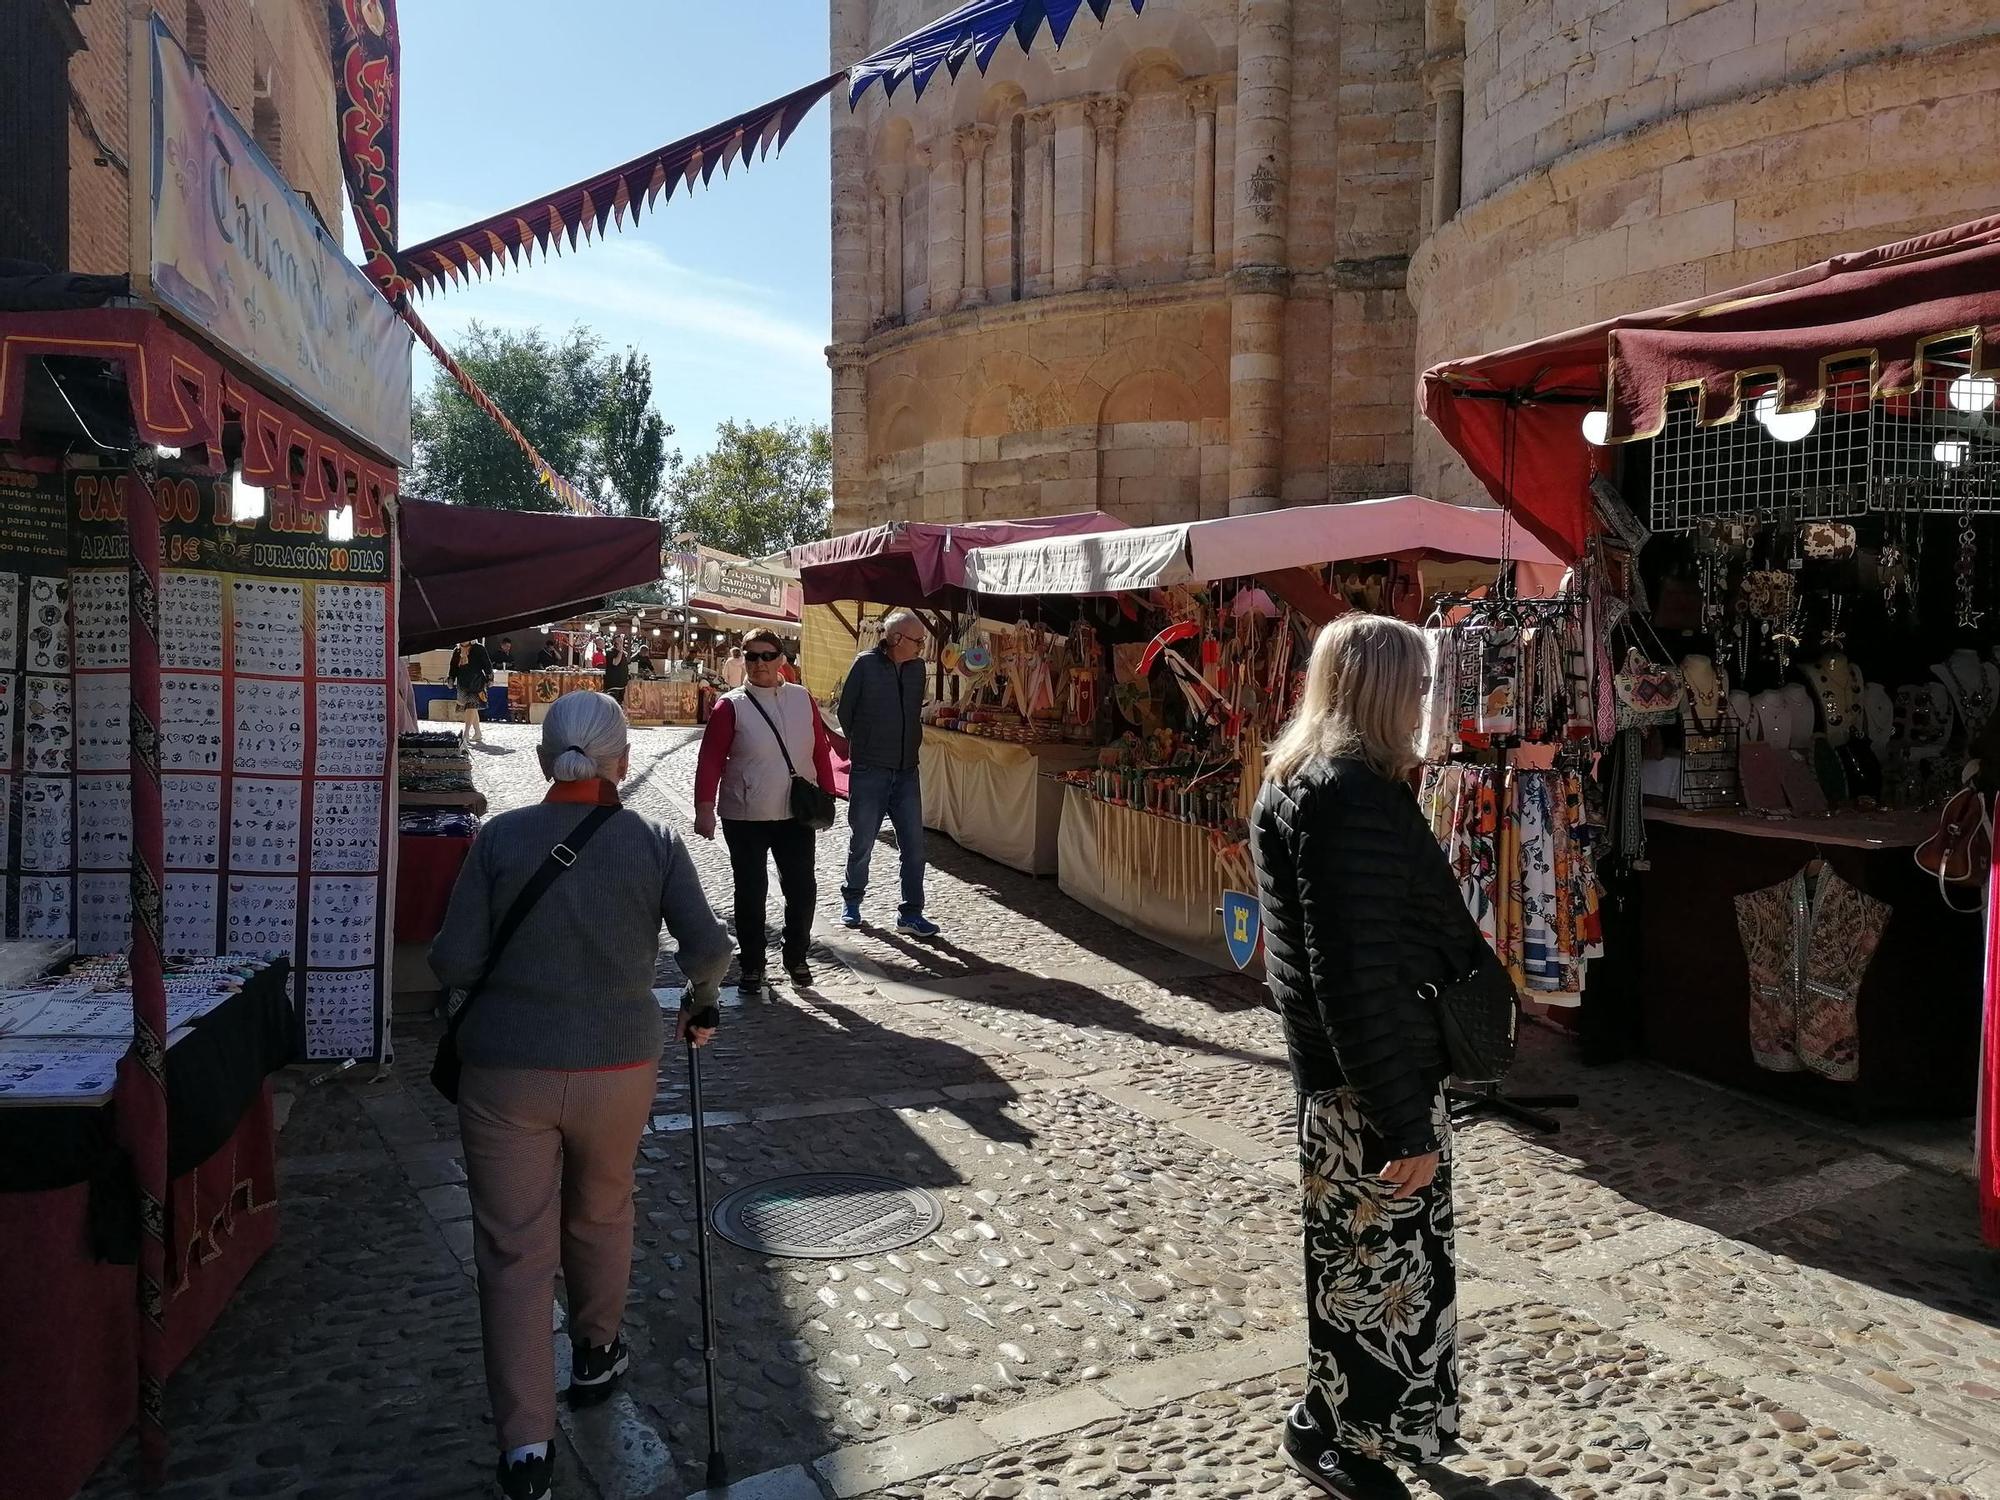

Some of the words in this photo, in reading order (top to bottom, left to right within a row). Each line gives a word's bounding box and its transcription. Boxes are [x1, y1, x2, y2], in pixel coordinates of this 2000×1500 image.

[0, 489, 32, 499] nutos
[7, 503, 38, 512] como
[74, 475, 200, 524] TATOO
[212, 481, 257, 530] D
[7, 516, 32, 526] para
[11, 529, 49, 541] dormir.
[94, 535, 129, 560] PART
[254, 542, 329, 570] DURACIÓN
[329, 549, 349, 571] 10
[350, 550, 385, 573] DIAS
